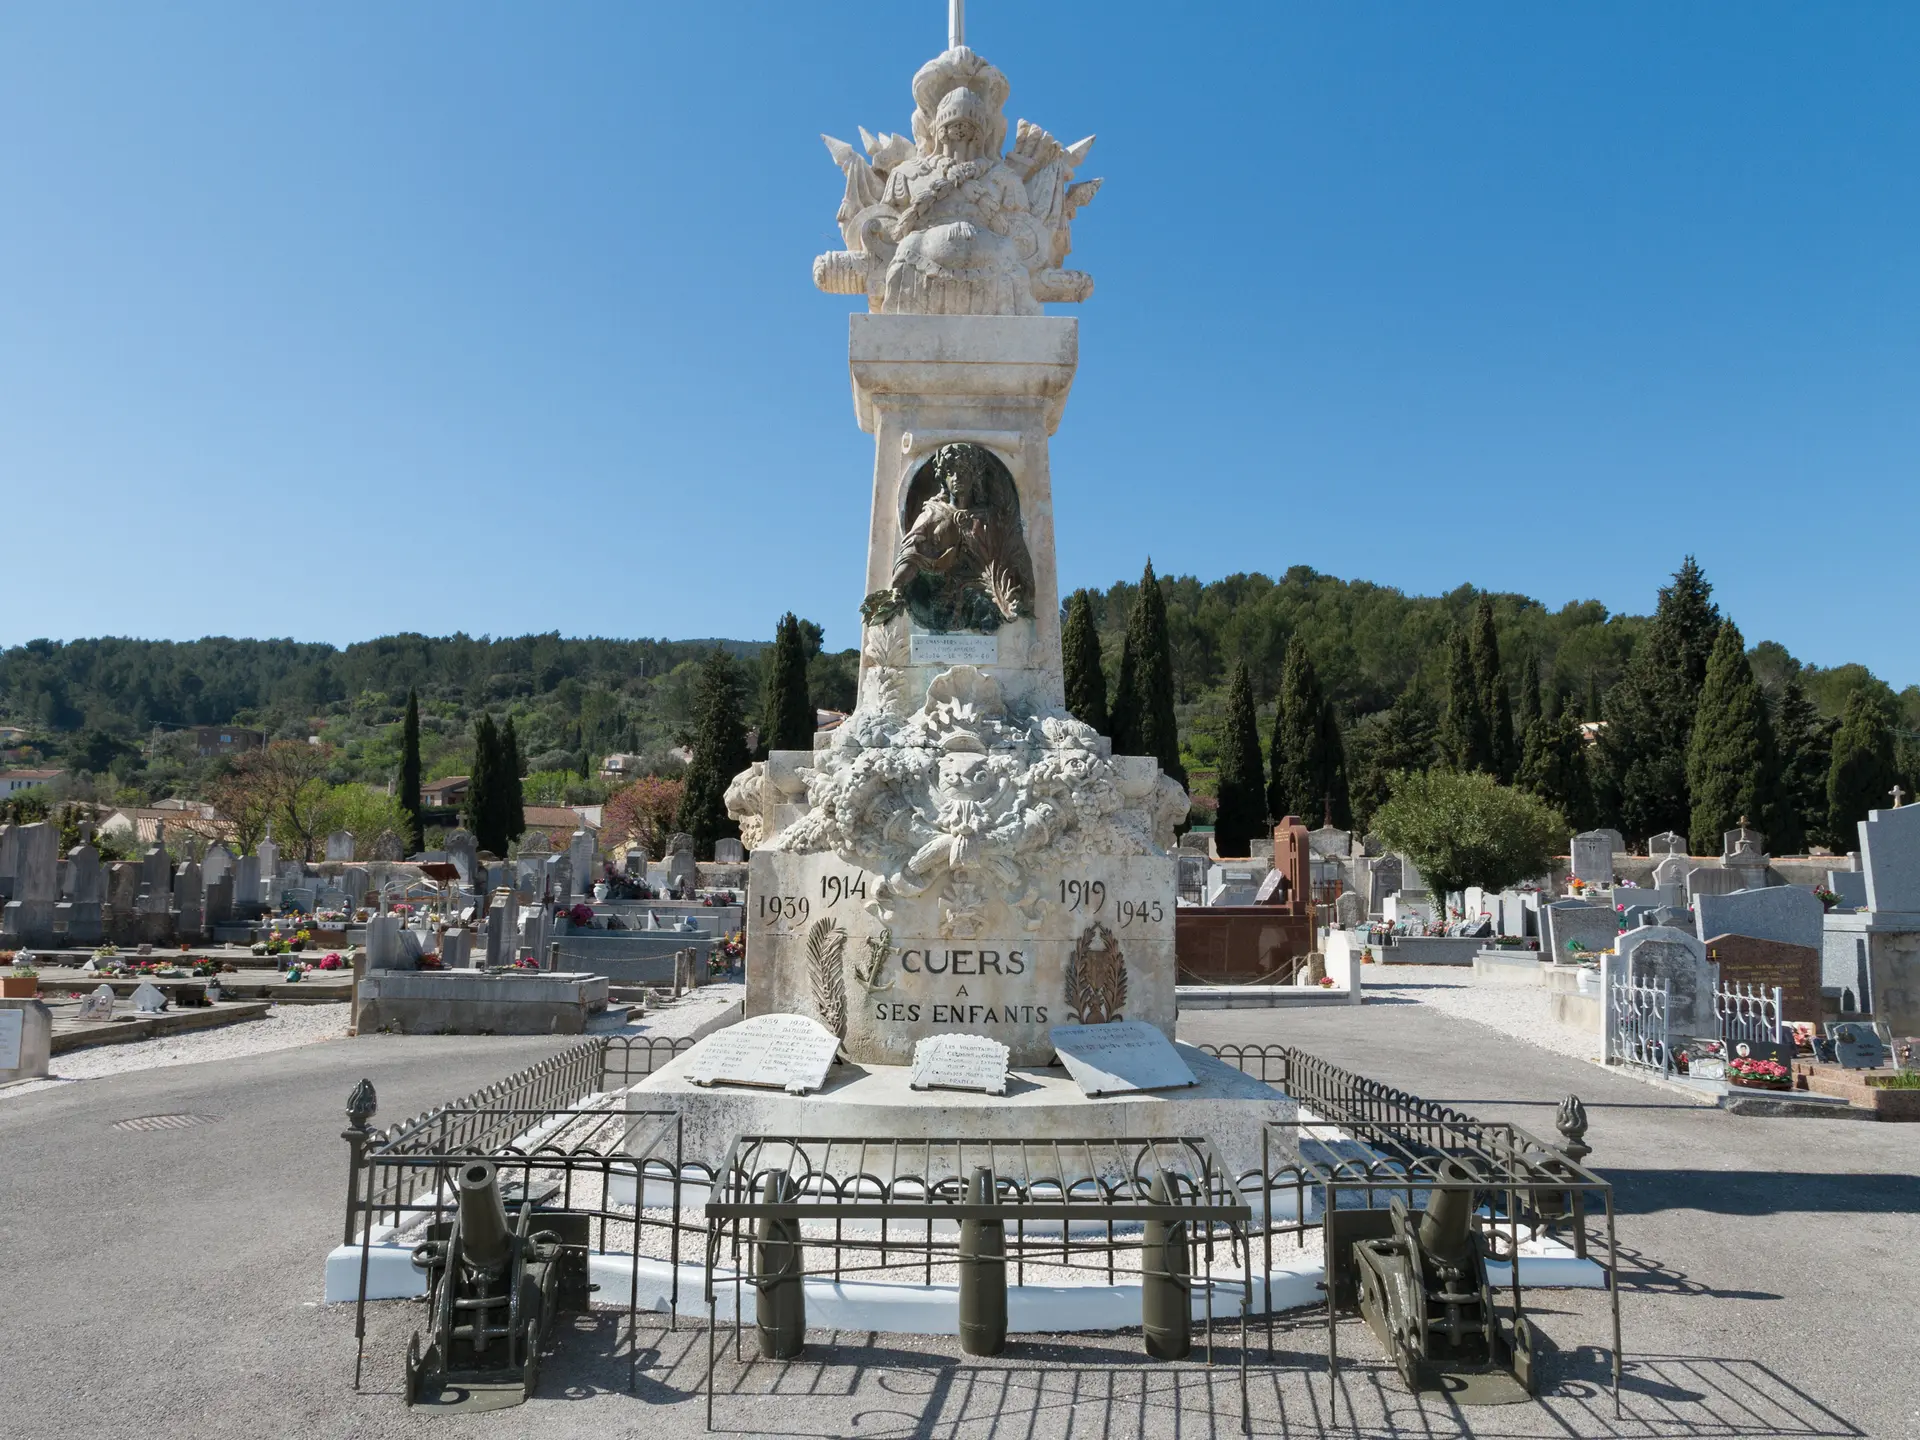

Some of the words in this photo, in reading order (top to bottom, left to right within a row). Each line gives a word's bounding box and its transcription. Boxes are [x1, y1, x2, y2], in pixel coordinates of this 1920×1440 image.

[820, 870, 867, 908] 1914
[1058, 878, 1107, 914] 1919
[759, 895, 810, 926] 1939
[1116, 899, 1164, 929] 1945
[901, 949, 1025, 975] CUERS
[956, 984, 969, 996] A
[875, 1002, 921, 1022] SES
[932, 1003, 1049, 1024] ENFANTS
